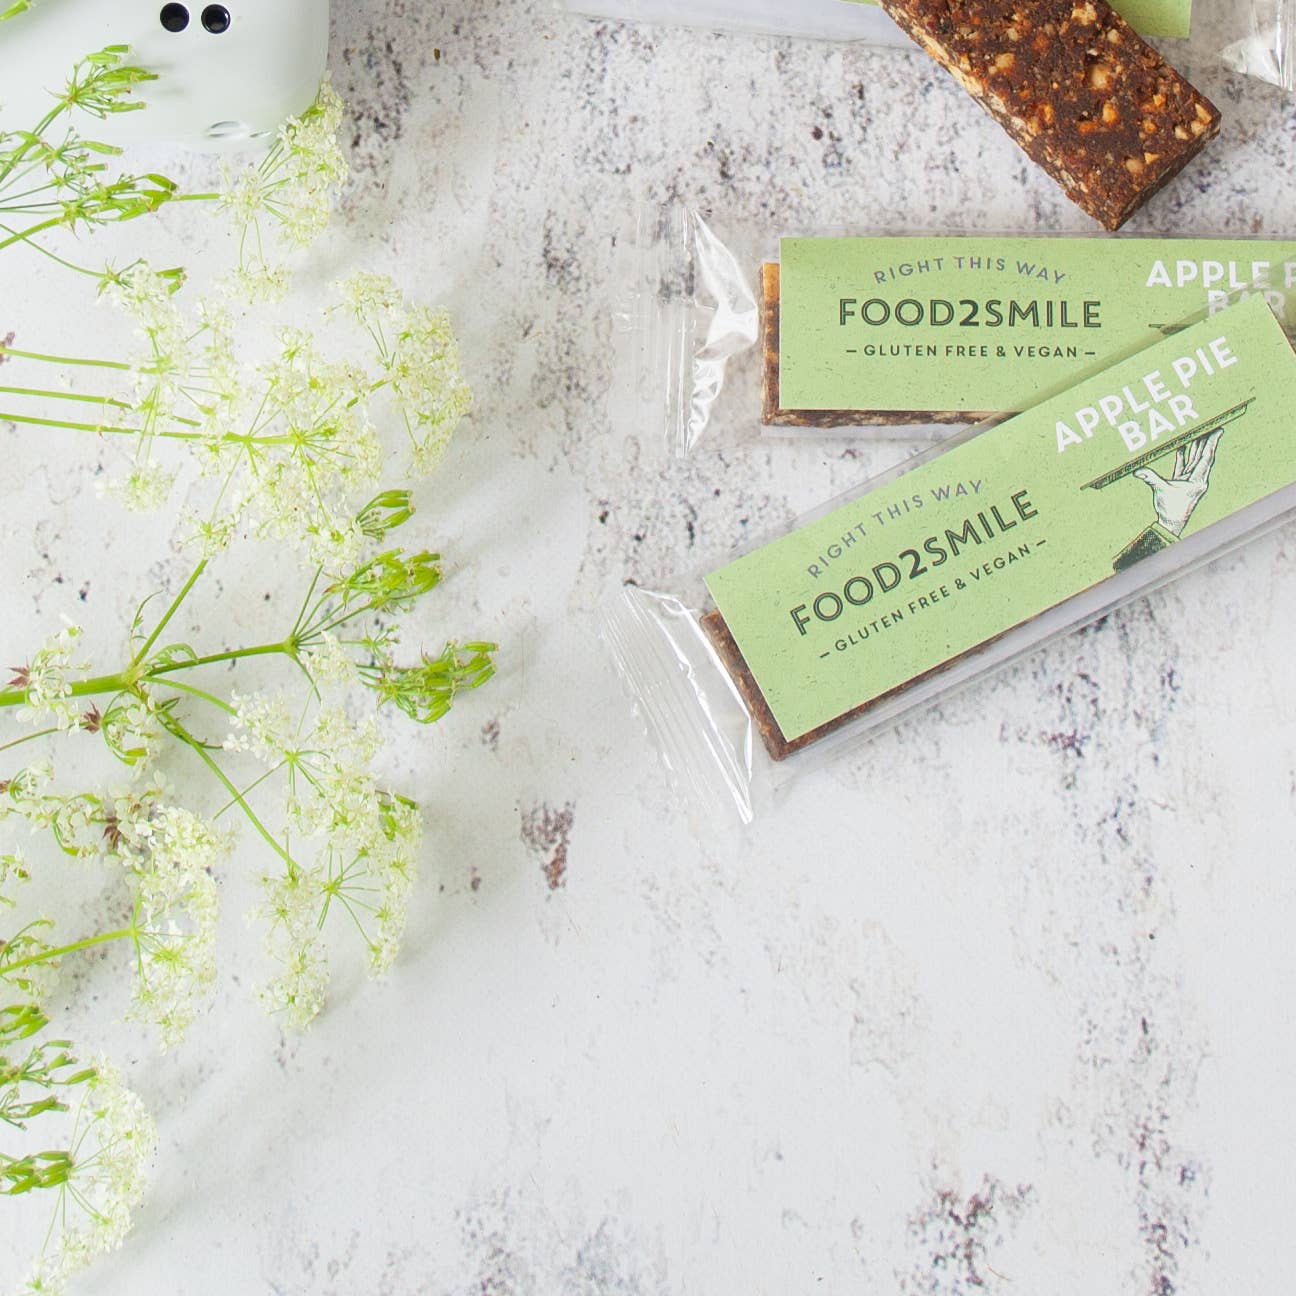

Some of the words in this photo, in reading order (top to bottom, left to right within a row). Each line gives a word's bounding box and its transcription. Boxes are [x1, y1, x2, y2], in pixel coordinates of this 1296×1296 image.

[874, 257, 944, 284] RIGHT
[953, 256, 1005, 272] THIS
[1016, 260, 1066, 285] WAY
[1145, 260, 1271, 289] APPLE
[839, 298, 1102, 328] FOOD2SMILE
[863, 344, 937, 357] GLUTEN
[945, 345, 988, 357] FREE
[996, 345, 1006, 357] &
[1014, 346, 1077, 358] VEGAN
[1055, 369, 1172, 454] APPLE
[1171, 335, 1238, 389] PIE
[1117, 394, 1200, 453] BAR
[807, 522, 868, 579] RIGHT
[872, 494, 924, 526] THIS
[930, 479, 983, 503] WAY
[789, 489, 1039, 636] FOOD2SMILE
[834, 608, 904, 652] GLUTEN
[907, 585, 950, 615] FREE
[955, 577, 967, 590] &
[969, 543, 1031, 581] VEGAN
